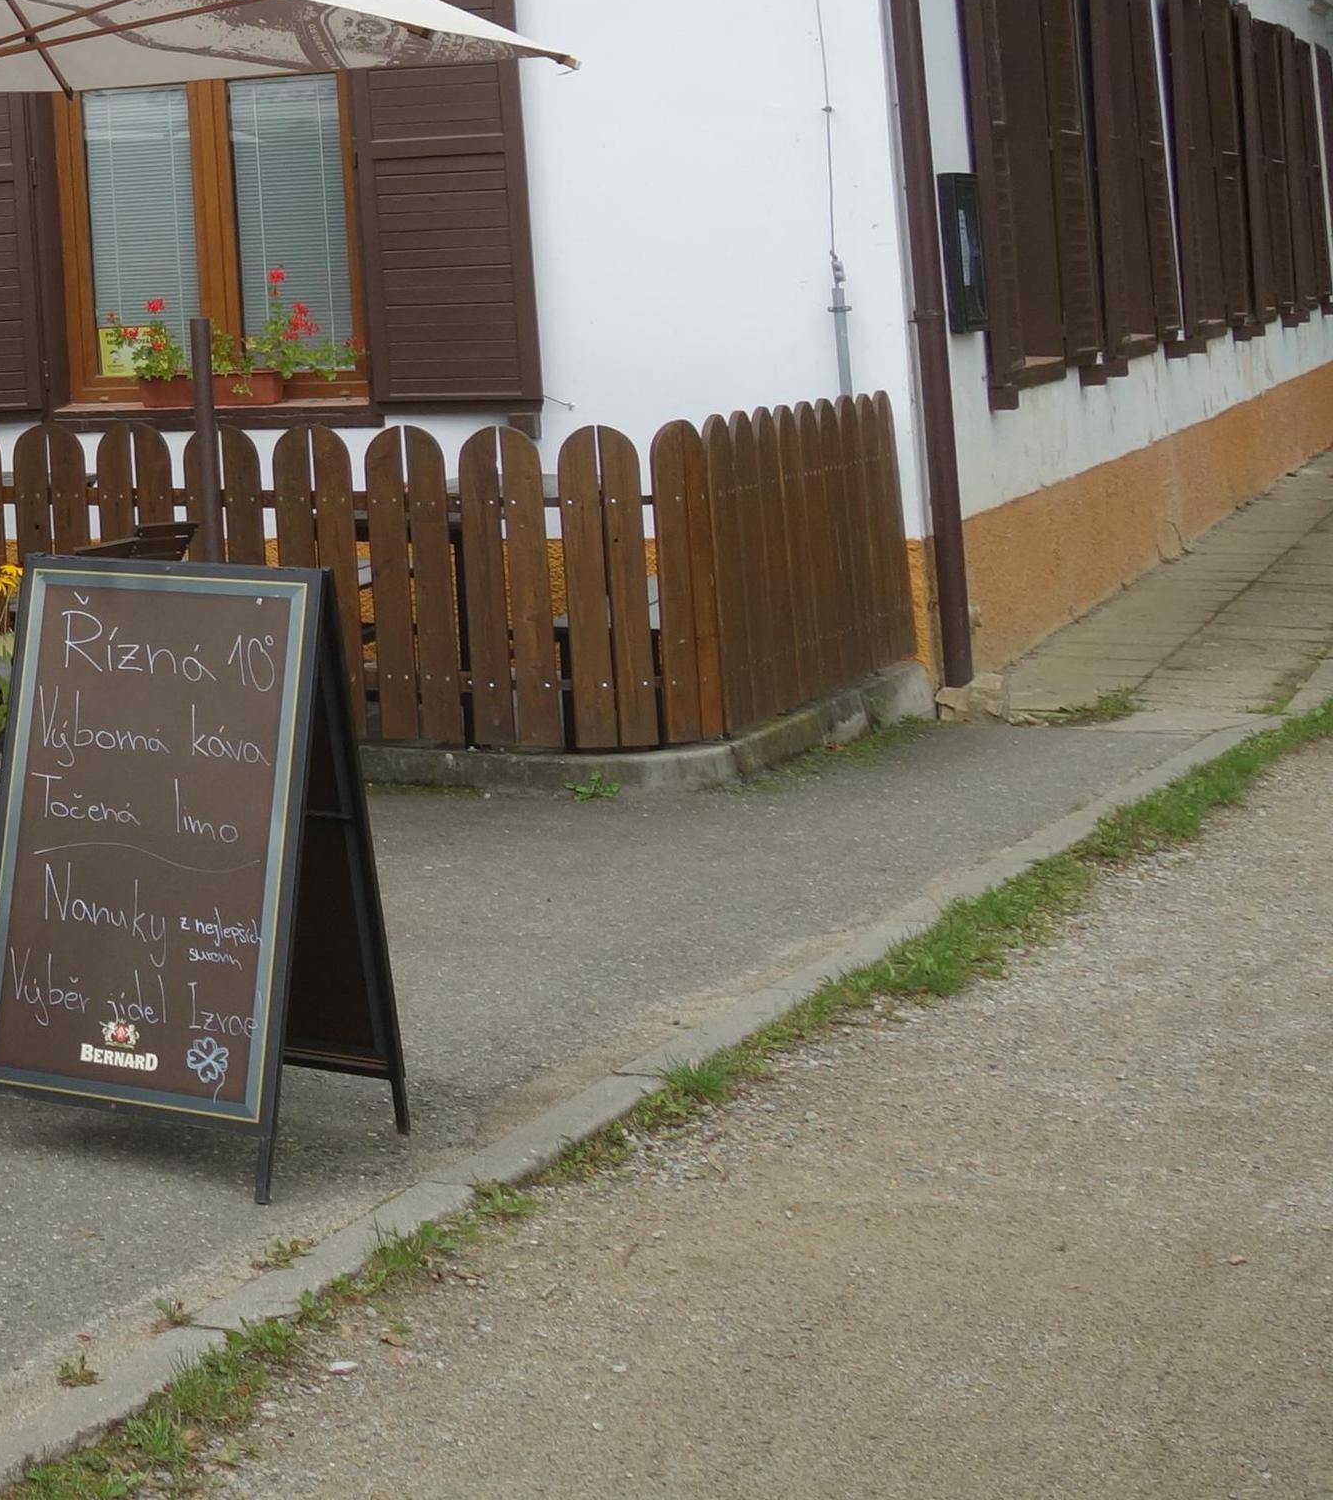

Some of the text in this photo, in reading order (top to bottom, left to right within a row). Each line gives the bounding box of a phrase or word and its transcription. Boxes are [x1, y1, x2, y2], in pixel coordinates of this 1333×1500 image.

[61, 591, 217, 682] Řízná
[39, 684, 271, 768] Výborná káva
[31, 771, 239, 843] Točená limo
[44, 861, 167, 968] Nanuky
[10, 947, 90, 1027] Výběr
[99, 969, 167, 1027] jídel
[80, 1043, 159, 1072] BERNARD
